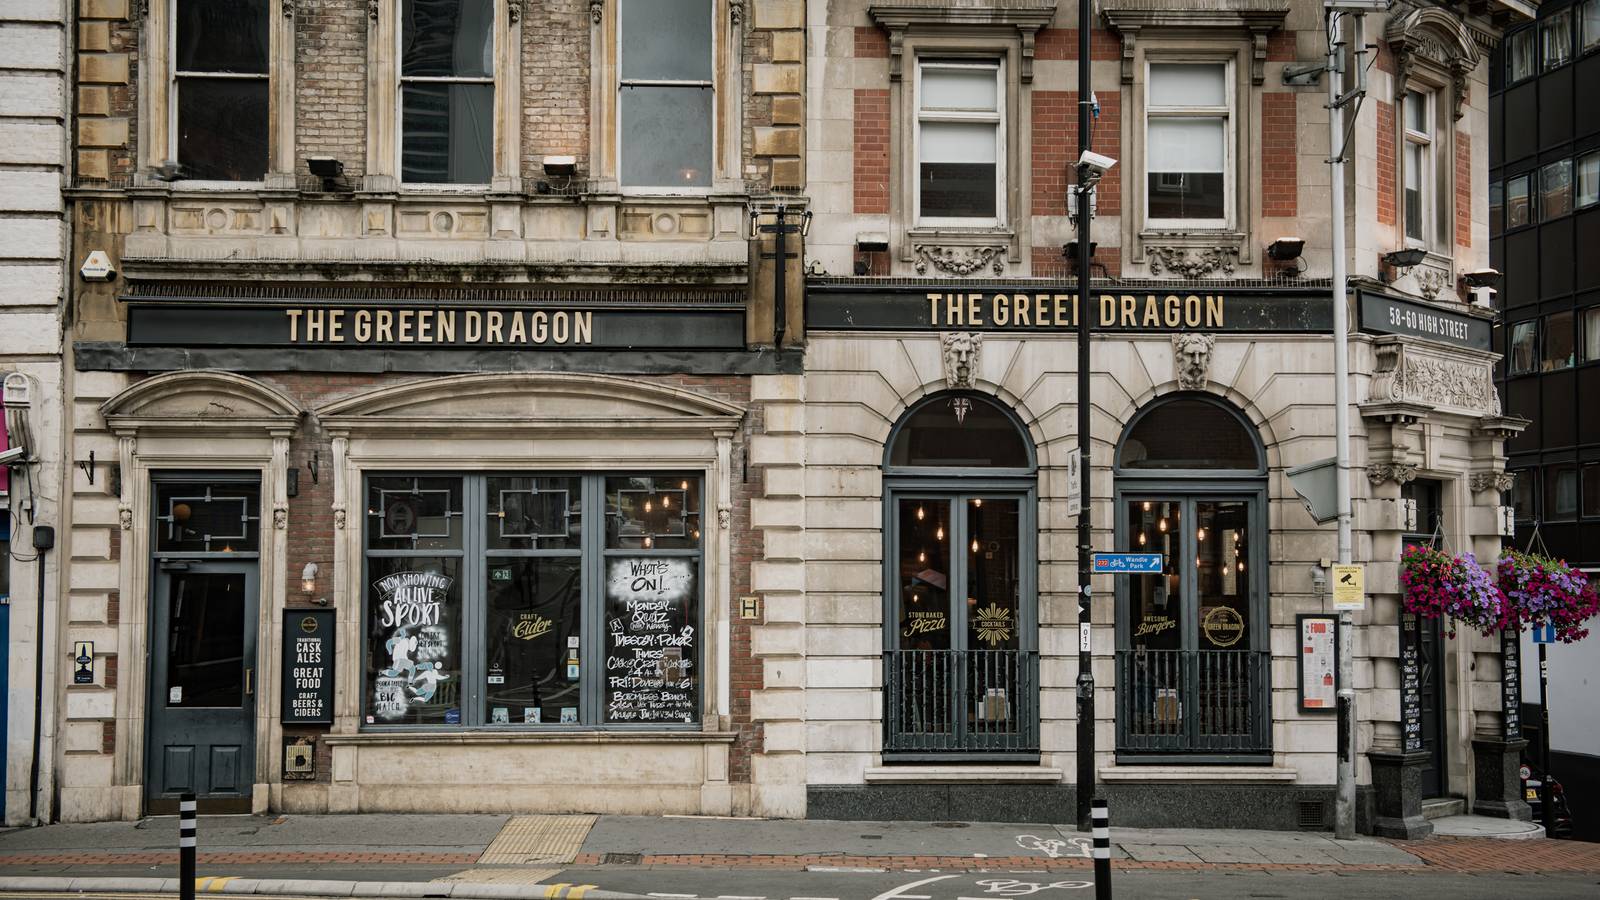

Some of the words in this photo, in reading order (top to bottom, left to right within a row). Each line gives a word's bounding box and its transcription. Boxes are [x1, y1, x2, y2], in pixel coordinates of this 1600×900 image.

[926, 293, 983, 326] THE
[1100, 294, 1224, 328] DRAGON
[286, 309, 345, 342] THE
[354, 310, 456, 343] GREEN
[464, 310, 593, 344] DRAGON
[1389, 306, 1417, 330] 58-60
[1418, 313, 1438, 334] HIGH
[1440, 318, 1468, 340] STREET
[381, 575, 400, 592] NOW
[402, 574, 446, 588] SHOWING
[413, 586, 434, 604] LIVE
[382, 600, 440, 628] SPORT
[743, 600, 756, 616] H
[512, 616, 552, 640] Cider
[904, 618, 946, 637] Pizza
[1134, 620, 1176, 636] Burgers
[296, 643, 321, 653] CASK
[297, 653, 321, 663] ALES
[293, 668, 324, 678] GREAT
[296, 679, 321, 689] FOOD
[317, 699, 323, 708] &
[380, 692, 396, 702] BIG
[294, 708, 321, 716] CIDERS
